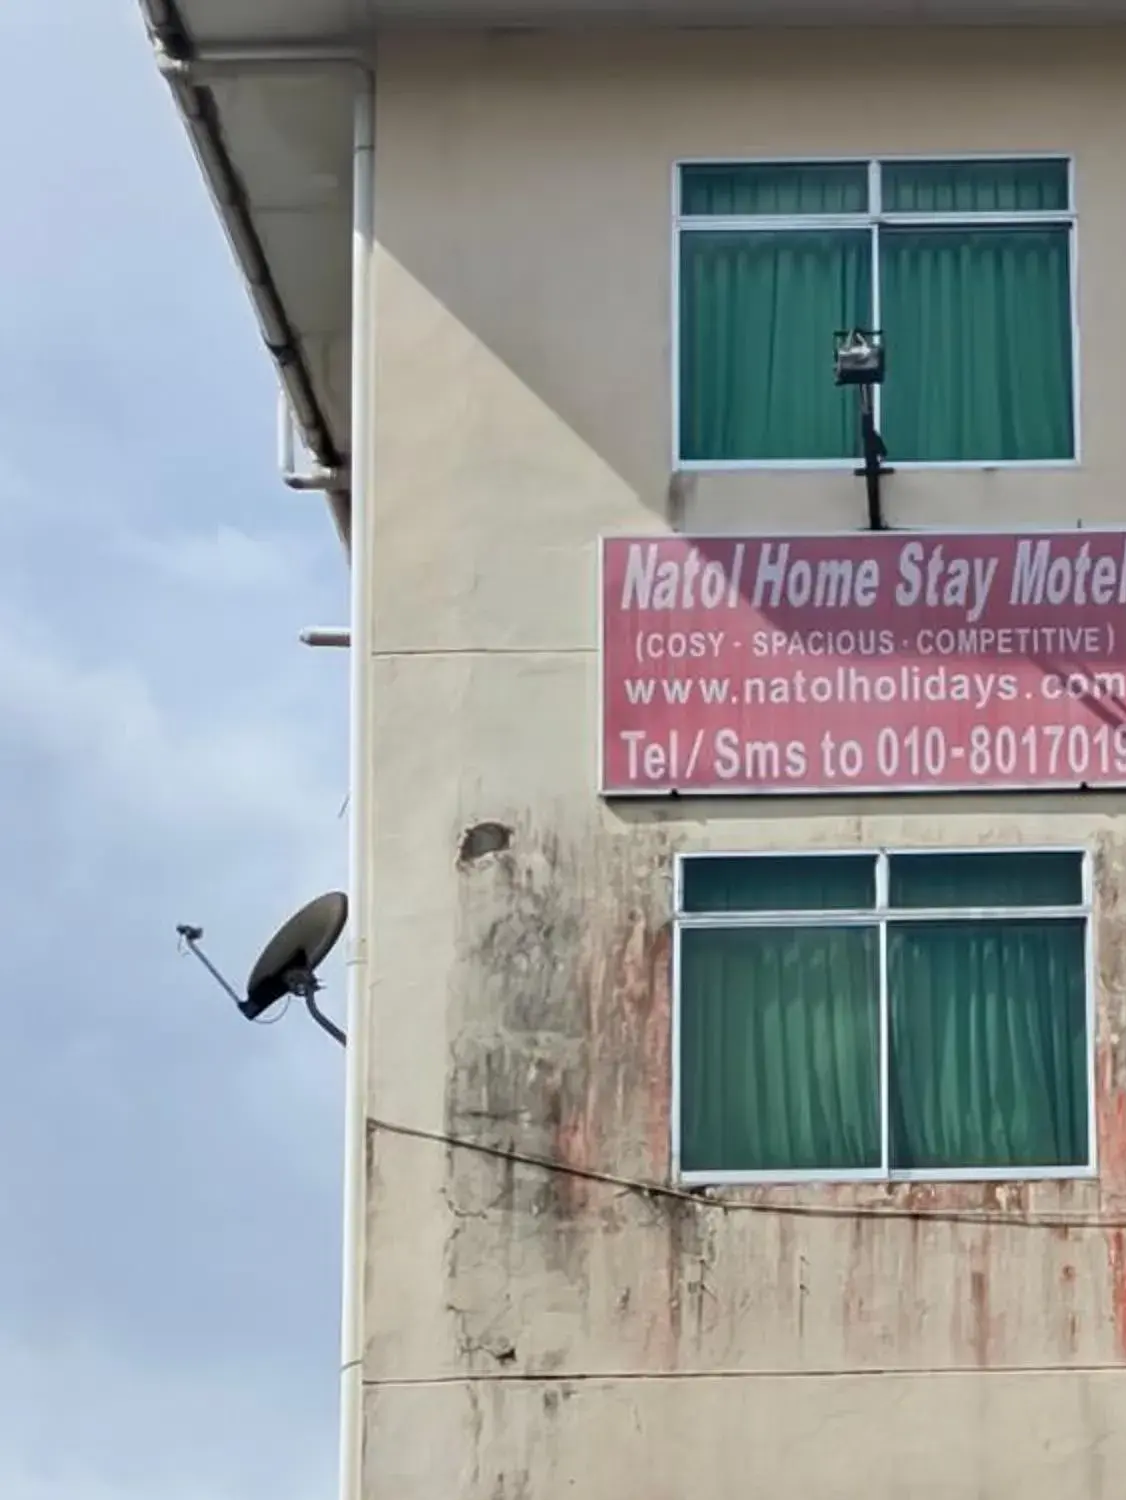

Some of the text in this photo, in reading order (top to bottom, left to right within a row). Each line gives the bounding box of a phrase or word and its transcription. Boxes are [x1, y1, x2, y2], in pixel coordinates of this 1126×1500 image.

[621, 543, 745, 609] Natol
[752, 543, 880, 608] Home
[895, 541, 998, 622] Stay
[635, 630, 726, 662] (COSY
[624, 666, 1126, 708] www.natolholidays.com
[820, 730, 864, 777] to
